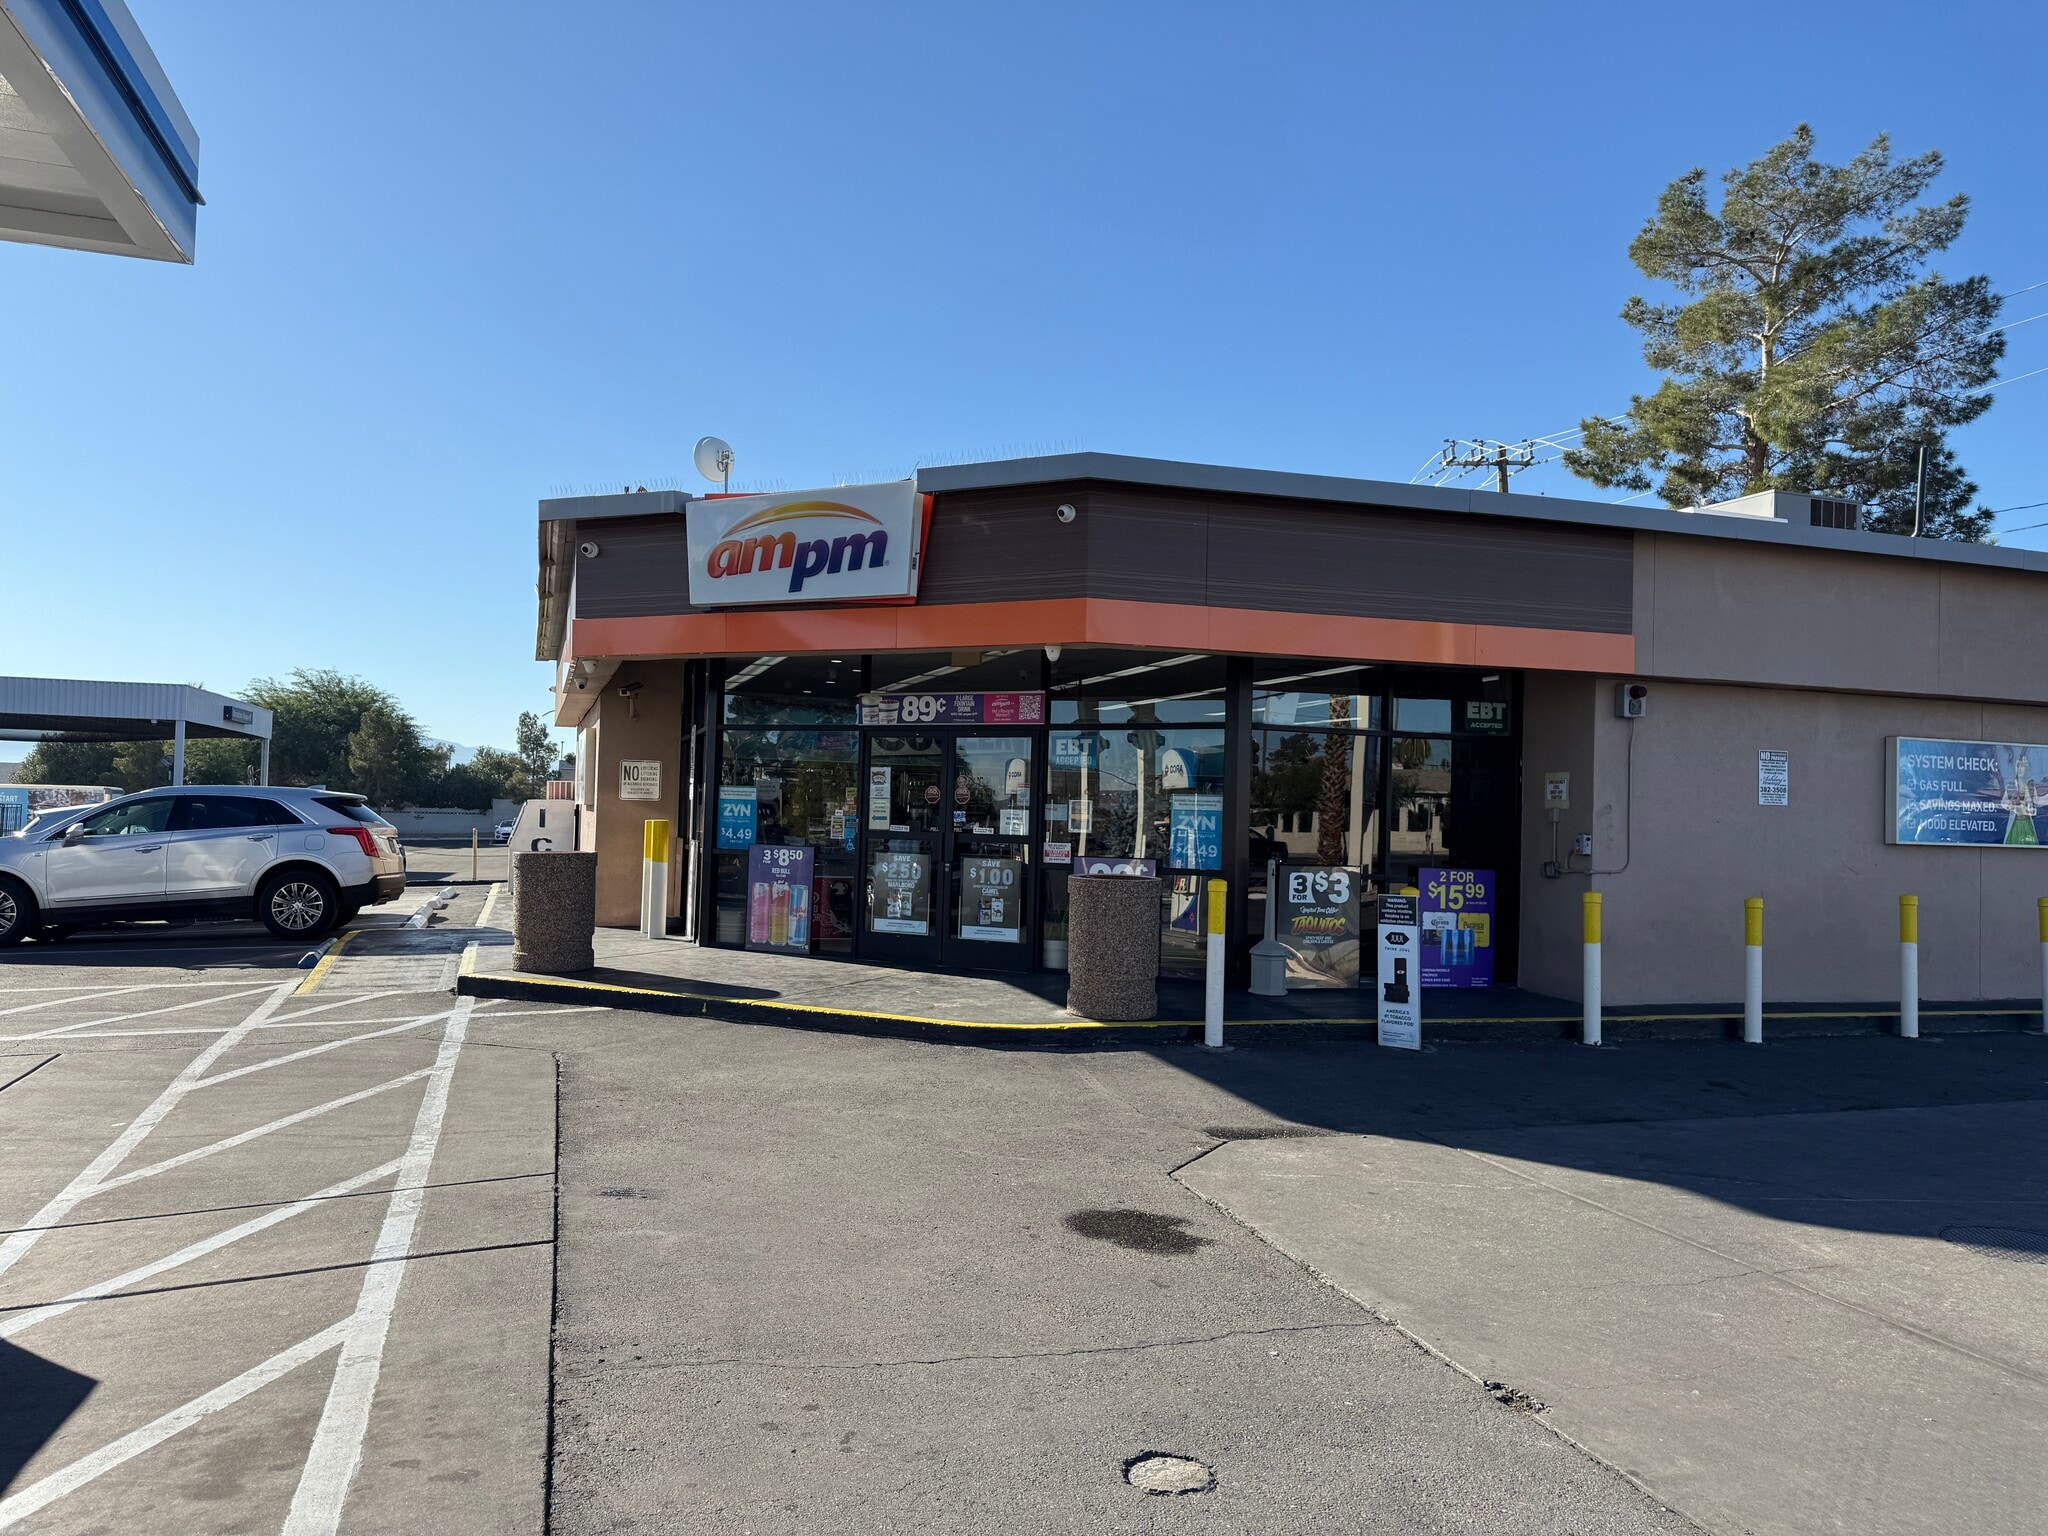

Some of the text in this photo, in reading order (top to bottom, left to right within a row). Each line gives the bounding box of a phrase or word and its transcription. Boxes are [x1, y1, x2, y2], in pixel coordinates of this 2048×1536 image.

[707, 530, 888, 593] ampm
[902, 696, 946, 722] 89¢
[1467, 701, 1506, 720] EBT
[1056, 739, 1092, 755] EBT
[1056, 756, 1092, 765] ACCEPTED
[1761, 752, 1770, 760] NO
[1908, 754, 1998, 772] SYSTEM CHECK:
[624, 766, 639, 781] NO
[1920, 780, 1967, 792] GAS FULL.
[723, 804, 751, 816] ZYN
[1920, 800, 1997, 812] SAVINGS MAXED.
[1178, 816, 1216, 830] ZYN
[1950, 819, 1997, 832] ELEVATED.
[722, 828, 752, 840] $4.49
[763, 850, 772, 860] 3
[882, 862, 922, 880] $2.50
[982, 860, 1000, 868] SAVE
[970, 866, 1014, 885] $1.00
[1440, 871, 1474, 882] 2 FOR
[1293, 871, 1350, 903] 3 $3
[1292, 916, 1346, 934] TAQUITOS
